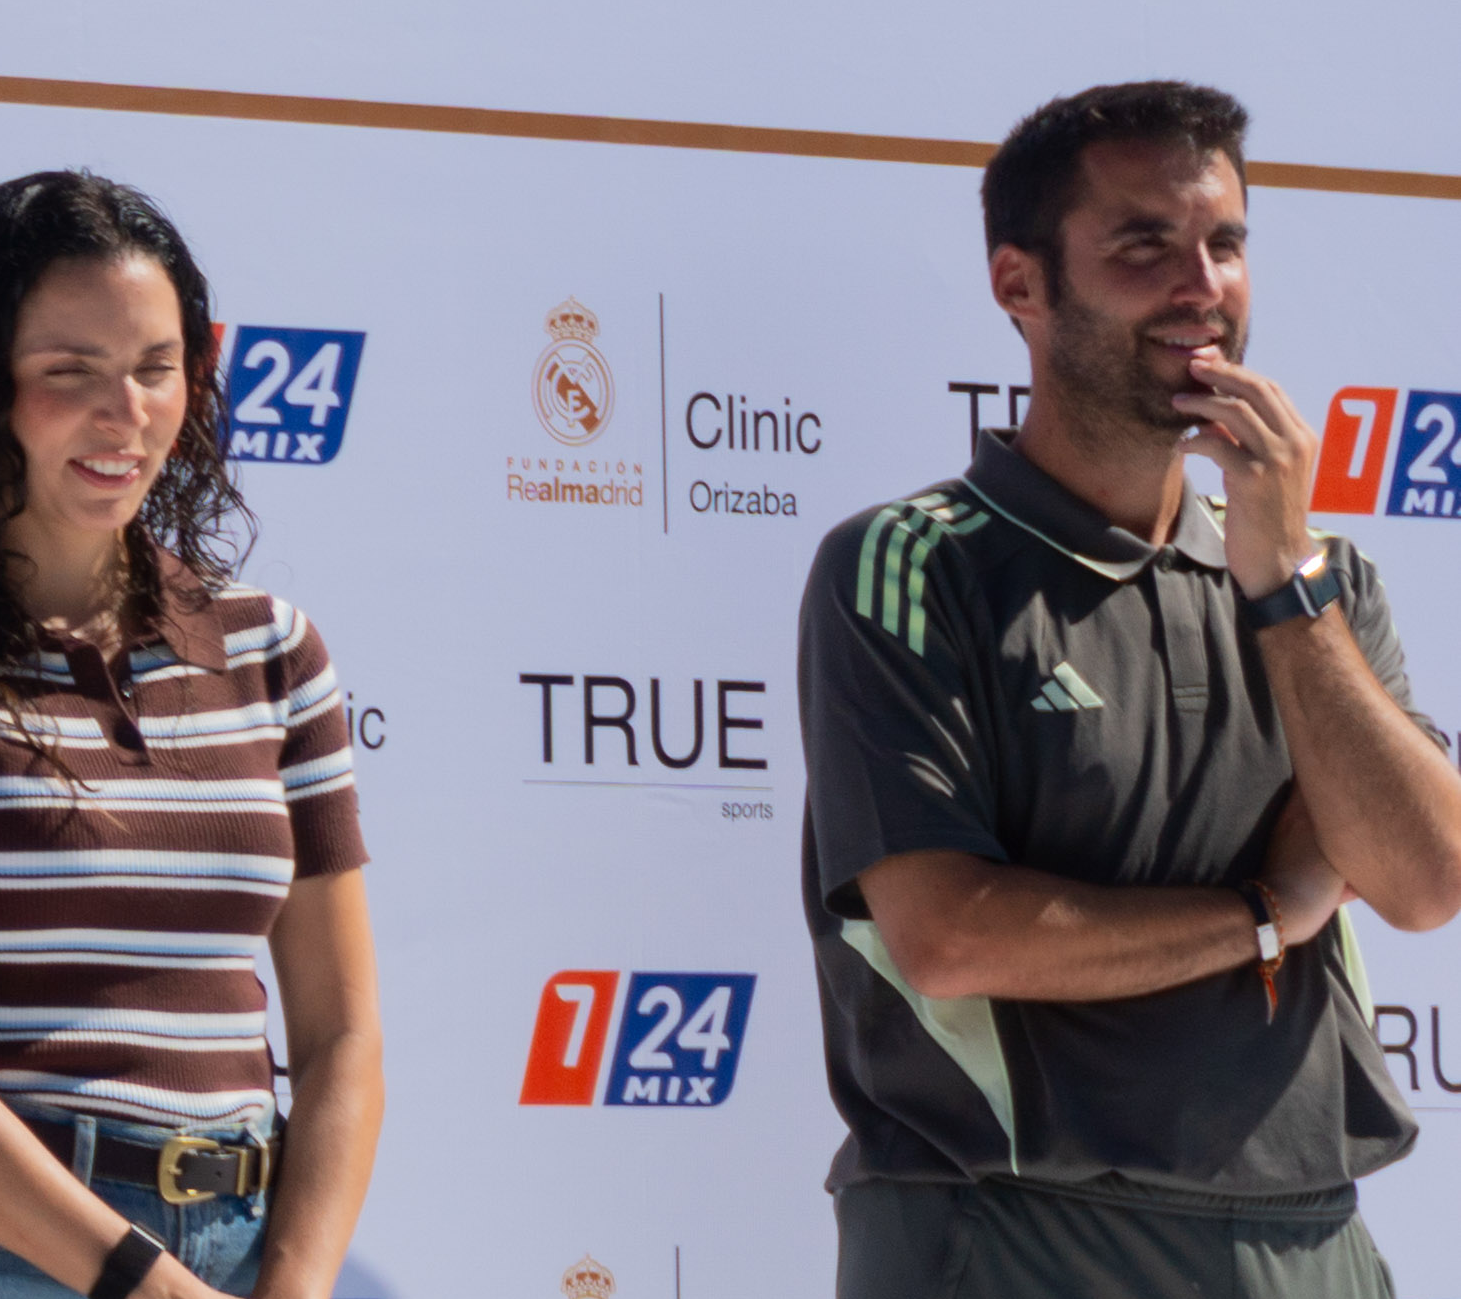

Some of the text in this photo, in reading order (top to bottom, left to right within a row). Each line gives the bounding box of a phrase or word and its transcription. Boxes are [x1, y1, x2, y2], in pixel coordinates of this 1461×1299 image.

[234, 339, 342, 426] 24
[686, 392, 821, 454] Clinic
[229, 430, 324, 462] MIX
[508, 474, 642, 506] Realmadrid
[690, 480, 797, 516] Orizaba
[520, 674, 767, 769] TRUE
[722, 802, 773, 822] sports
[628, 985, 734, 1070] 24
[624, 1077, 713, 1104] MIX
